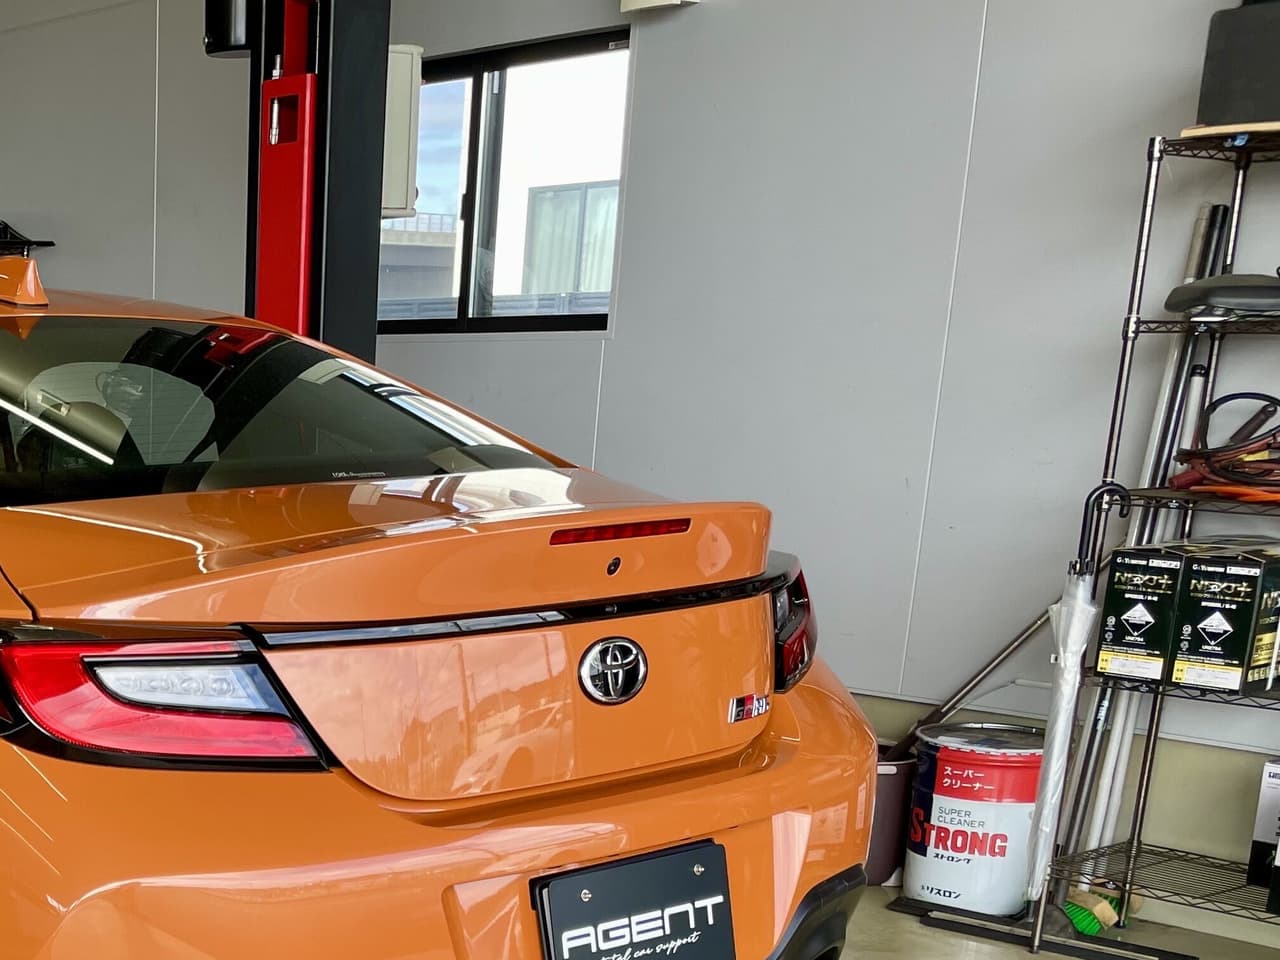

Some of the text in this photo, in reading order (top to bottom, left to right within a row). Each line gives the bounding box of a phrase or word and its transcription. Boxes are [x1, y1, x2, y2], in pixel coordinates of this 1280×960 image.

[944, 766, 985, 779] スーパー
[942, 778, 996, 791] クリーナー
[938, 806, 972, 818] SUPER
[937, 816, 985, 828] CLEANER
[911, 807, 1008, 858] STRONG
[933, 852, 973, 865] ストロング
[561, 895, 724, 960] AGENT
[633, 947, 654, 959] car
[655, 931, 702, 957] support
